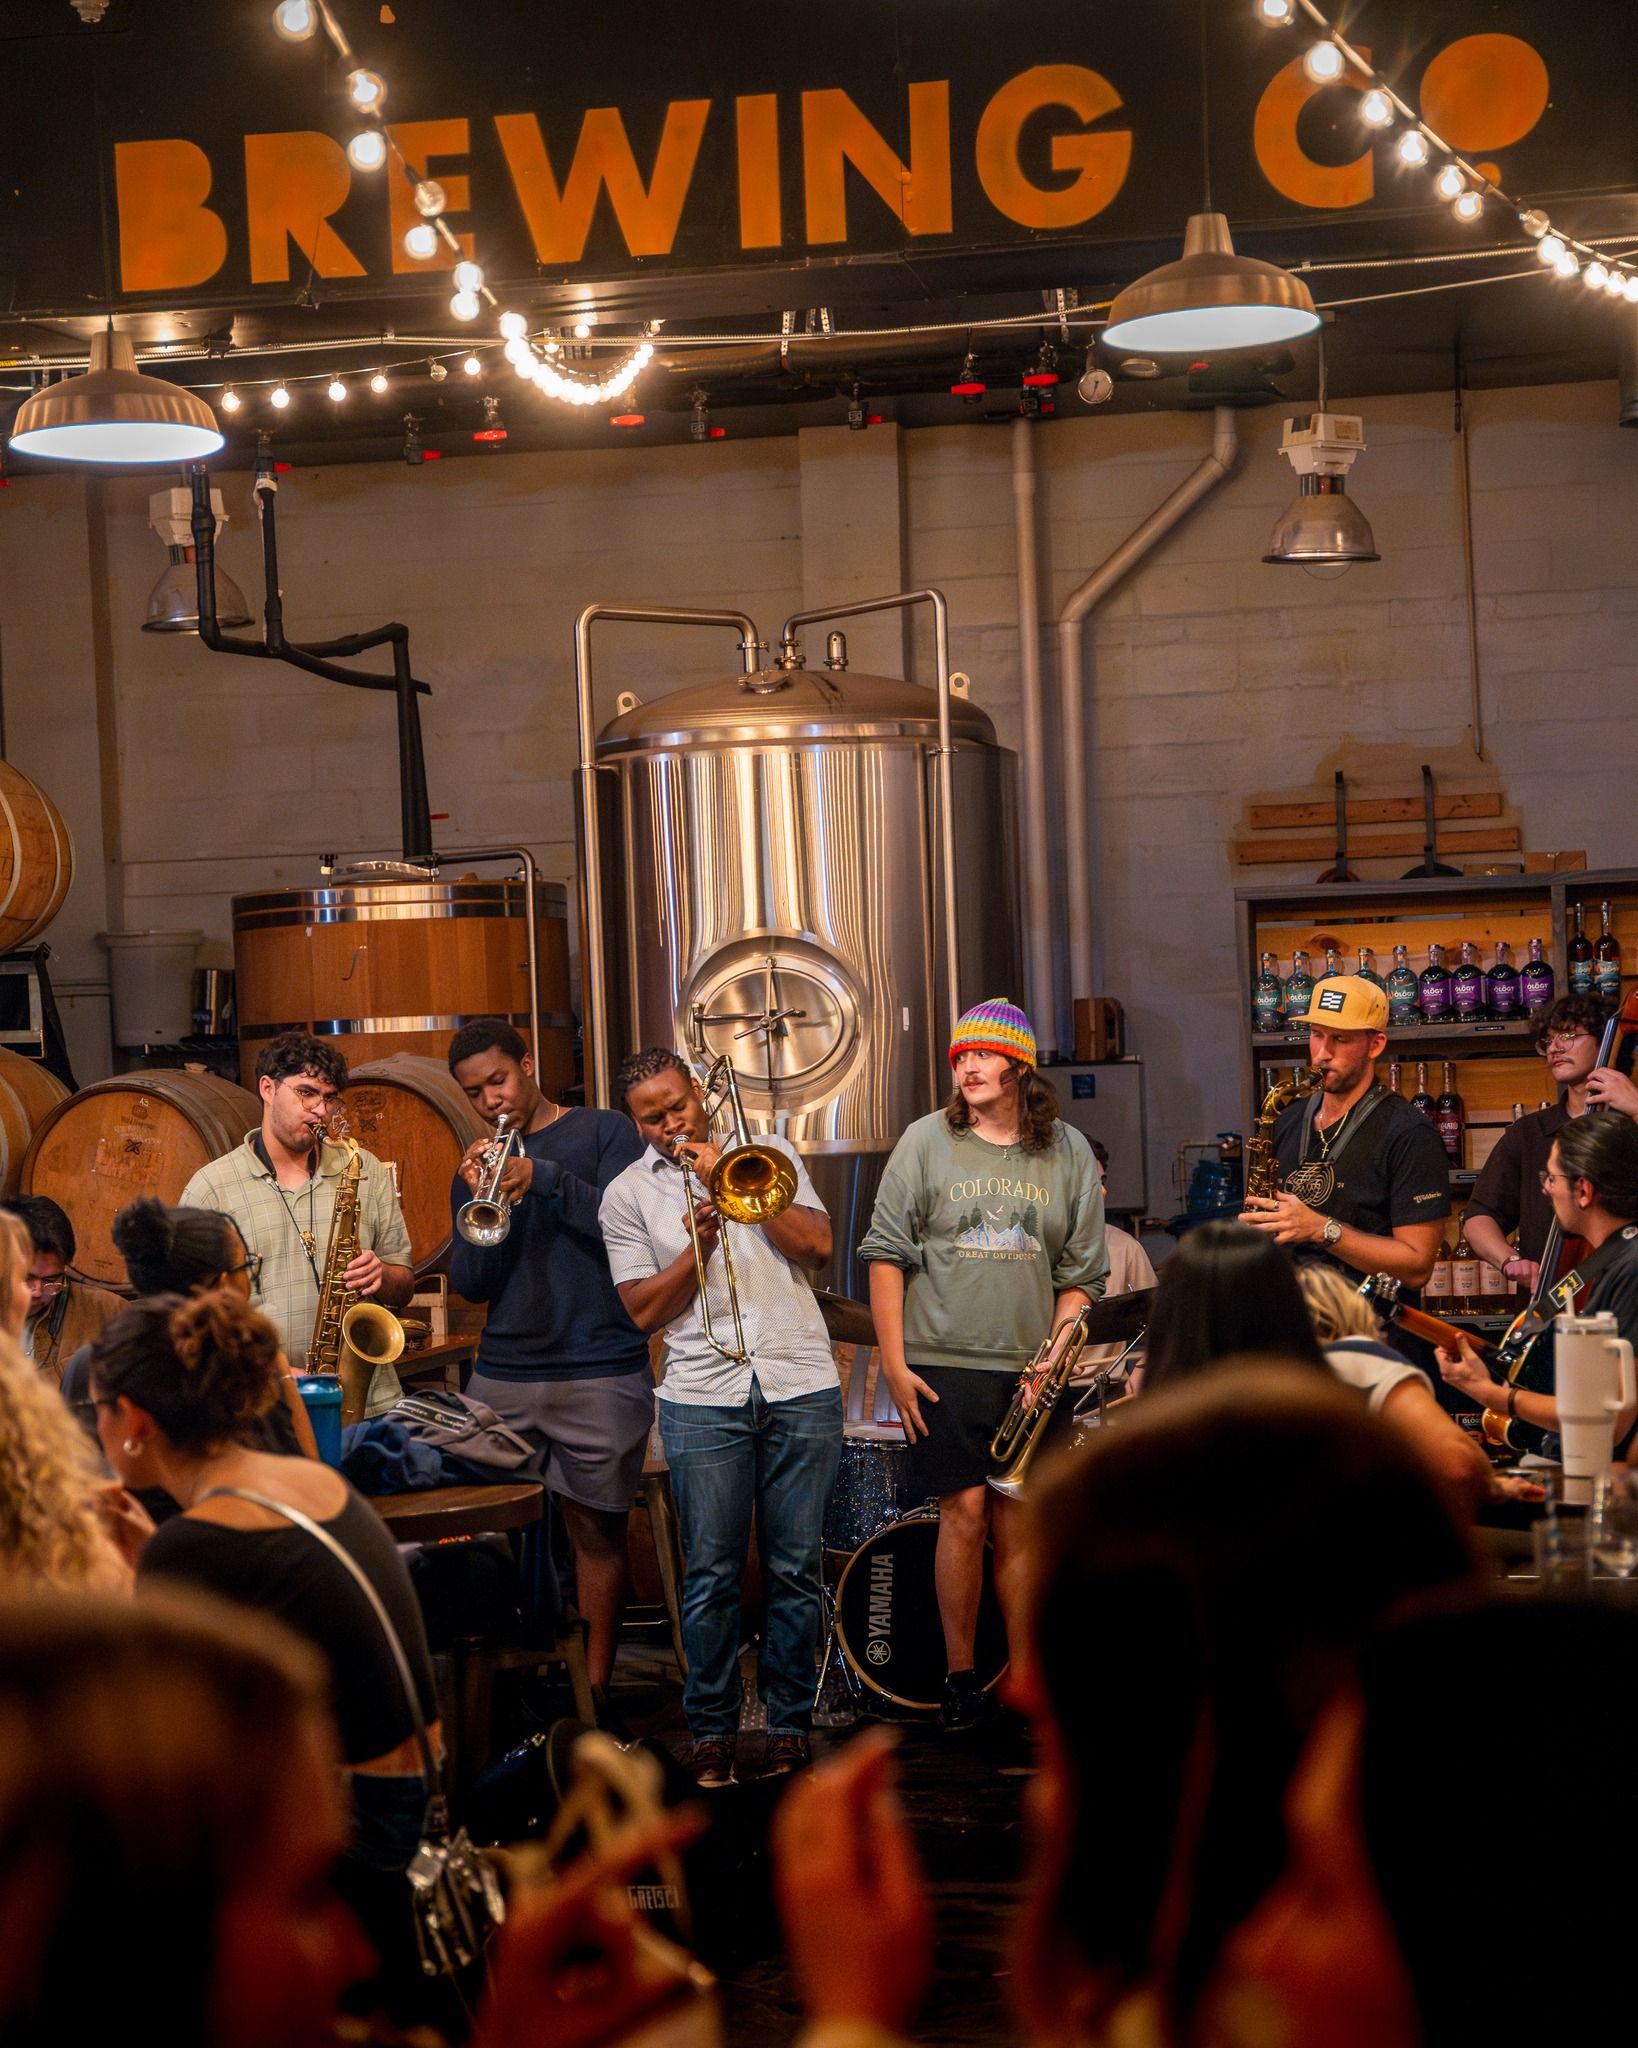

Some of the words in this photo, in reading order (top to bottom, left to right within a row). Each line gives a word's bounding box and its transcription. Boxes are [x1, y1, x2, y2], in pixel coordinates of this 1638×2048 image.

[115, 63, 1133, 293] BREWING
[950, 1177, 1049, 1206] COLORADO
[959, 1250, 989, 1259] GREAT
[868, 1554, 893, 1637] YAMAHA
